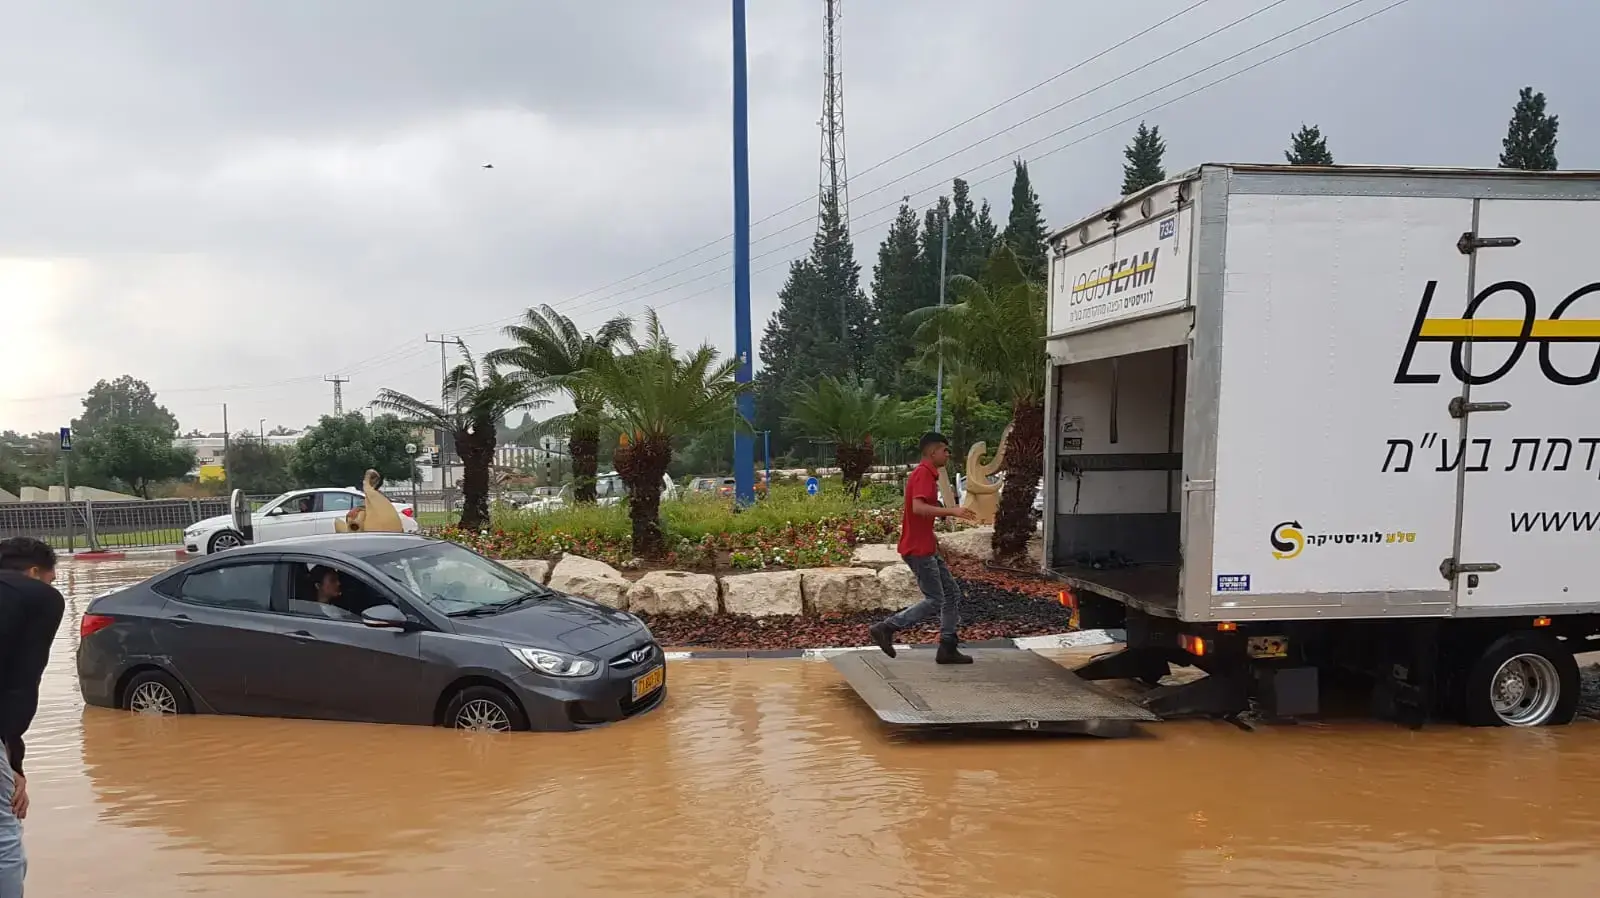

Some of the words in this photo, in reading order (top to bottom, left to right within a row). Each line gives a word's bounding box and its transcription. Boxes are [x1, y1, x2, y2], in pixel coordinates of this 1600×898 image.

[1160, 221, 1174, 237] 732
[1070, 247, 1160, 306] LOGISTEAM
[1124, 288, 1153, 308] לוגיסטים
[1381, 432, 1492, 473] בע"מ
[1504, 437, 1600, 480] דמת
[1307, 532, 1382, 546] לוגיסטיקה
[1386, 531, 1416, 544] סלע
